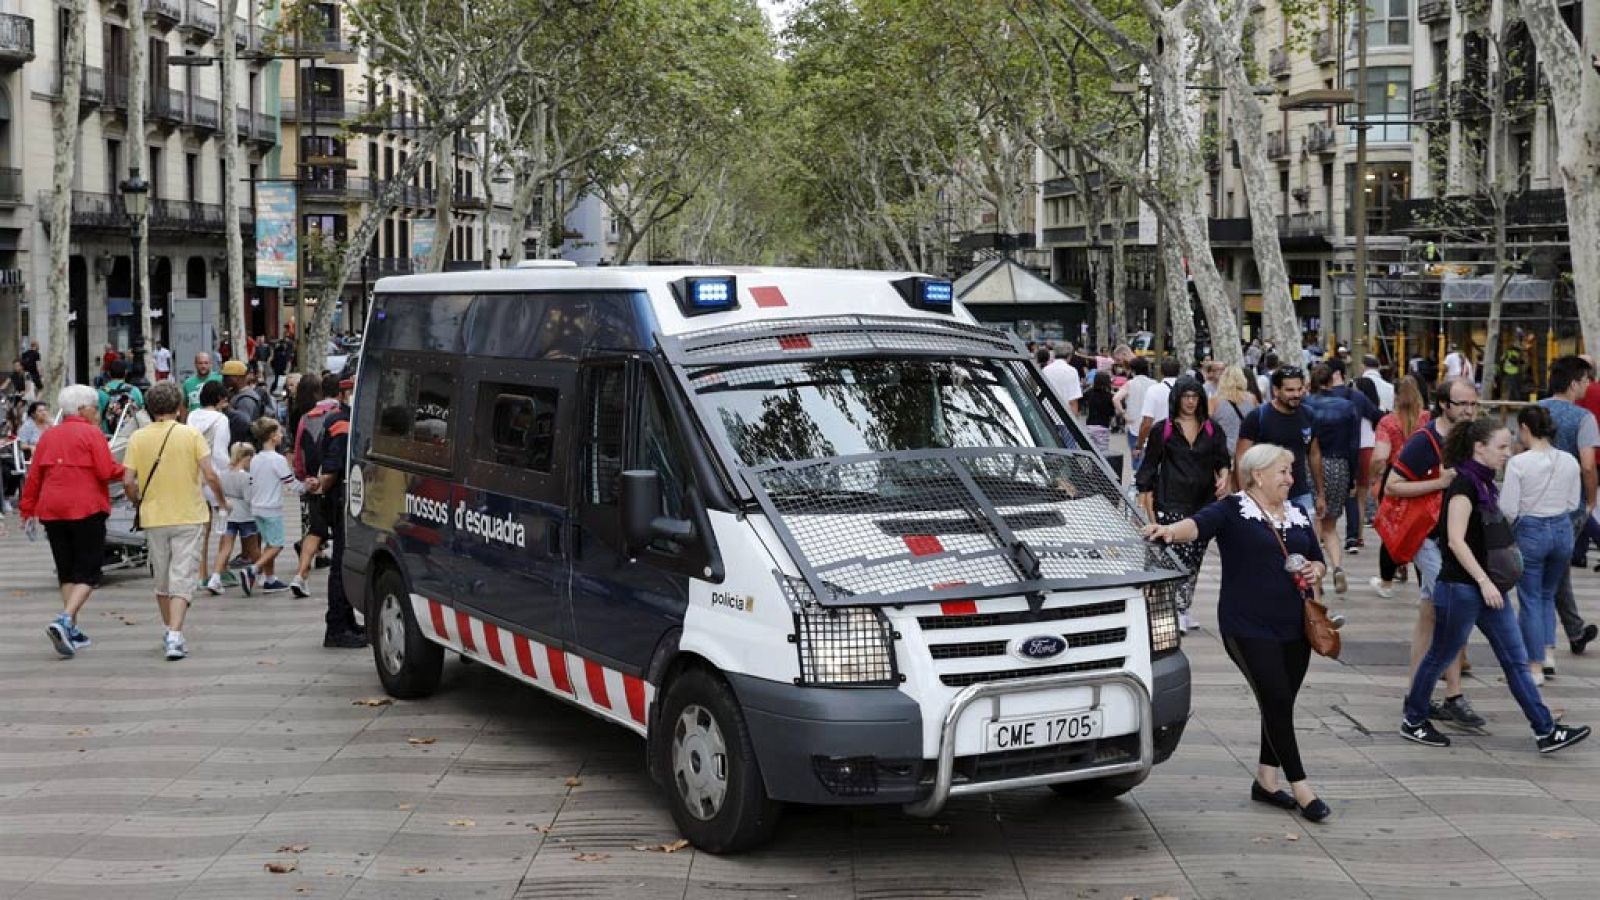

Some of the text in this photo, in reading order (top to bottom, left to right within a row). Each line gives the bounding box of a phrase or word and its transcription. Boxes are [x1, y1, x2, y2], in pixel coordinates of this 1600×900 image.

[405, 493, 526, 548] mossos d'esquadra
[711, 591, 744, 611] policia
[1029, 639, 1057, 655] Ford
[997, 714, 1092, 748] CME 1705
[1554, 730, 1567, 741] N
